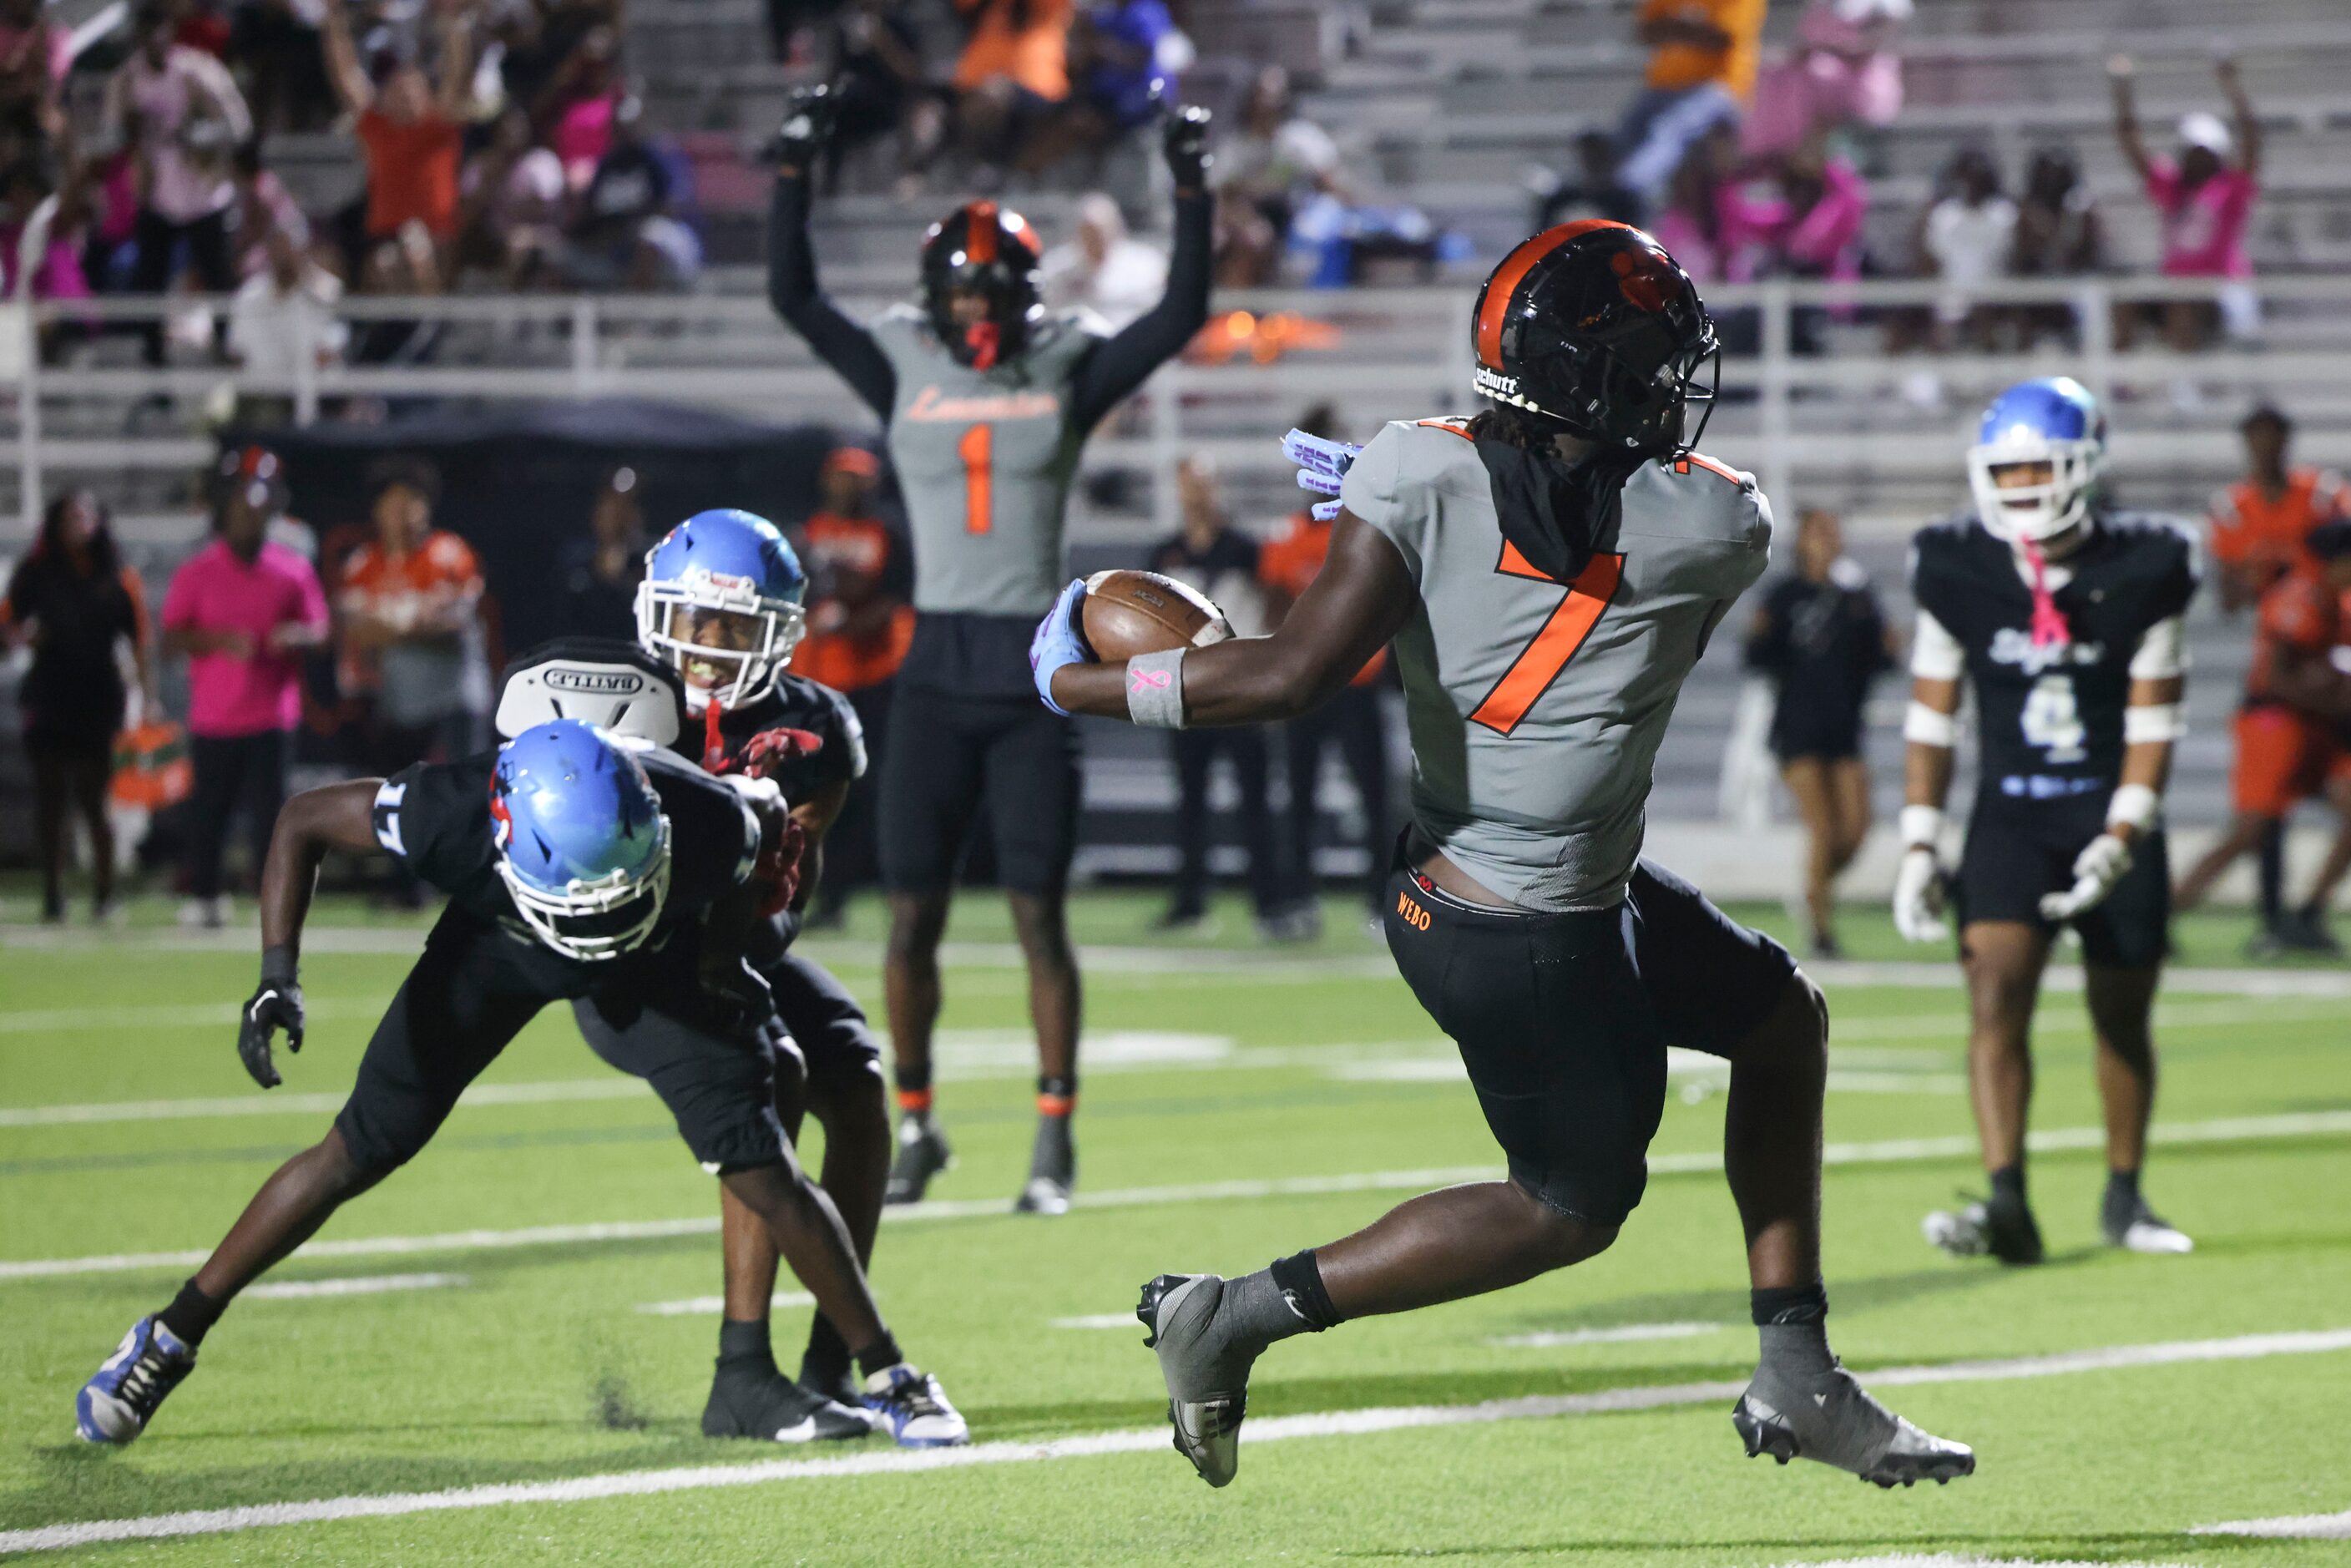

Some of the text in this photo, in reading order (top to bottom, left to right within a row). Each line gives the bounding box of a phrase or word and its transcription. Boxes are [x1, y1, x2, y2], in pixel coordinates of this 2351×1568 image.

[1475, 367, 1517, 394] schutt
[958, 422, 993, 535] 1
[1465, 536, 1628, 739] 7
[552, 673, 635, 690] BATTLE
[2020, 674, 2087, 765] 4
[374, 782, 407, 856] 17
[1397, 890, 1431, 932] WEBO
